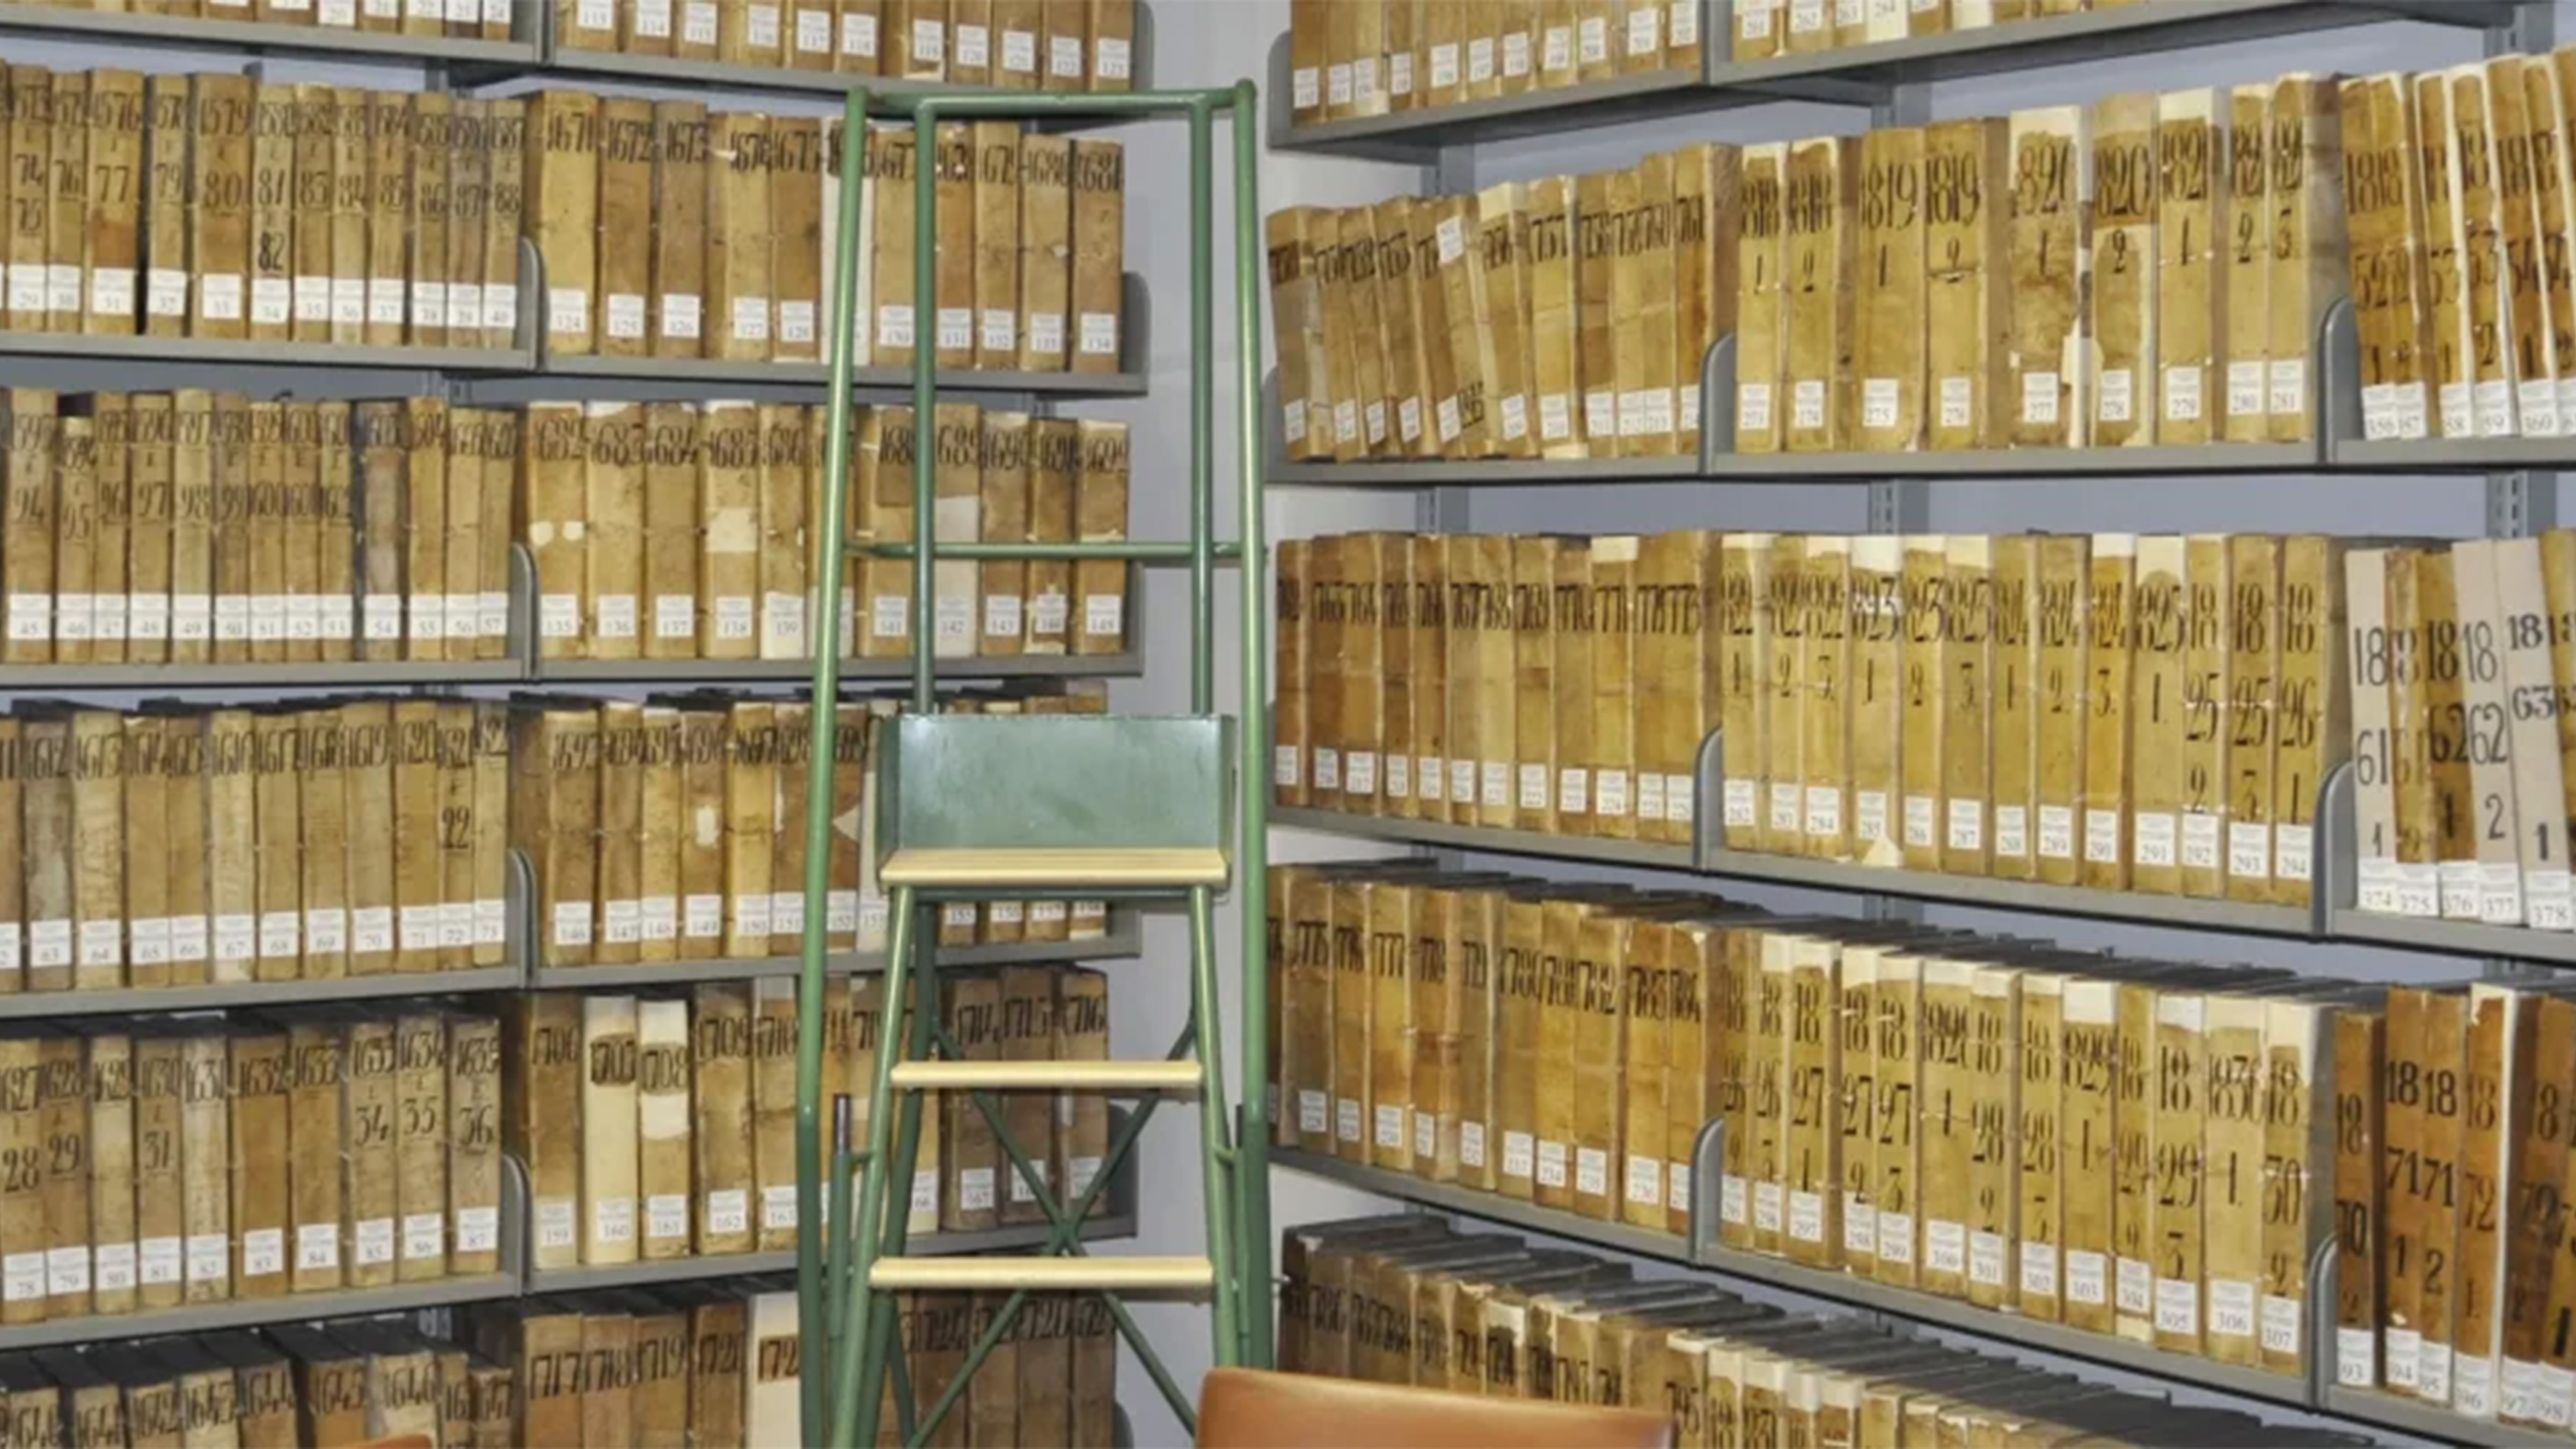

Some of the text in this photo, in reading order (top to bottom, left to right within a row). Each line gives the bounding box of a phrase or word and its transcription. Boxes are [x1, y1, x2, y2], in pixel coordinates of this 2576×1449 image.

[94, 165, 129, 203] 77
[258, 167, 285, 206] 81
[1861, 161, 1918, 231] 1819
[1926, 152, 1980, 226] 1819
[258, 232, 285, 272] 82
[2181, 217, 2190, 266] 1
[2235, 583, 2266, 654] 18
[2285, 583, 2315, 654] 18
[2508, 613, 2543, 651] 18
[2355, 627, 2389, 686] 18
[2427, 619, 2459, 682] 18
[2464, 620, 2498, 683] 18
[2470, 701, 2508, 764] 62
[2357, 729, 2388, 786] 61
[2485, 794, 2506, 840] 2
[2535, 823, 2550, 861] 1
[2387, 1060, 2419, 1106] 18
[2424, 1070, 2457, 1117] 18
[356, 1104, 389, 1147] 34
[3, 1146, 40, 1193] 28
[48, 1133, 81, 1175] 29
[144, 1129, 171, 1170] 31
[2387, 1147, 2419, 1195] 71
[2423, 1158, 2455, 1208] 71
[2425, 1248, 2444, 1294] 2
